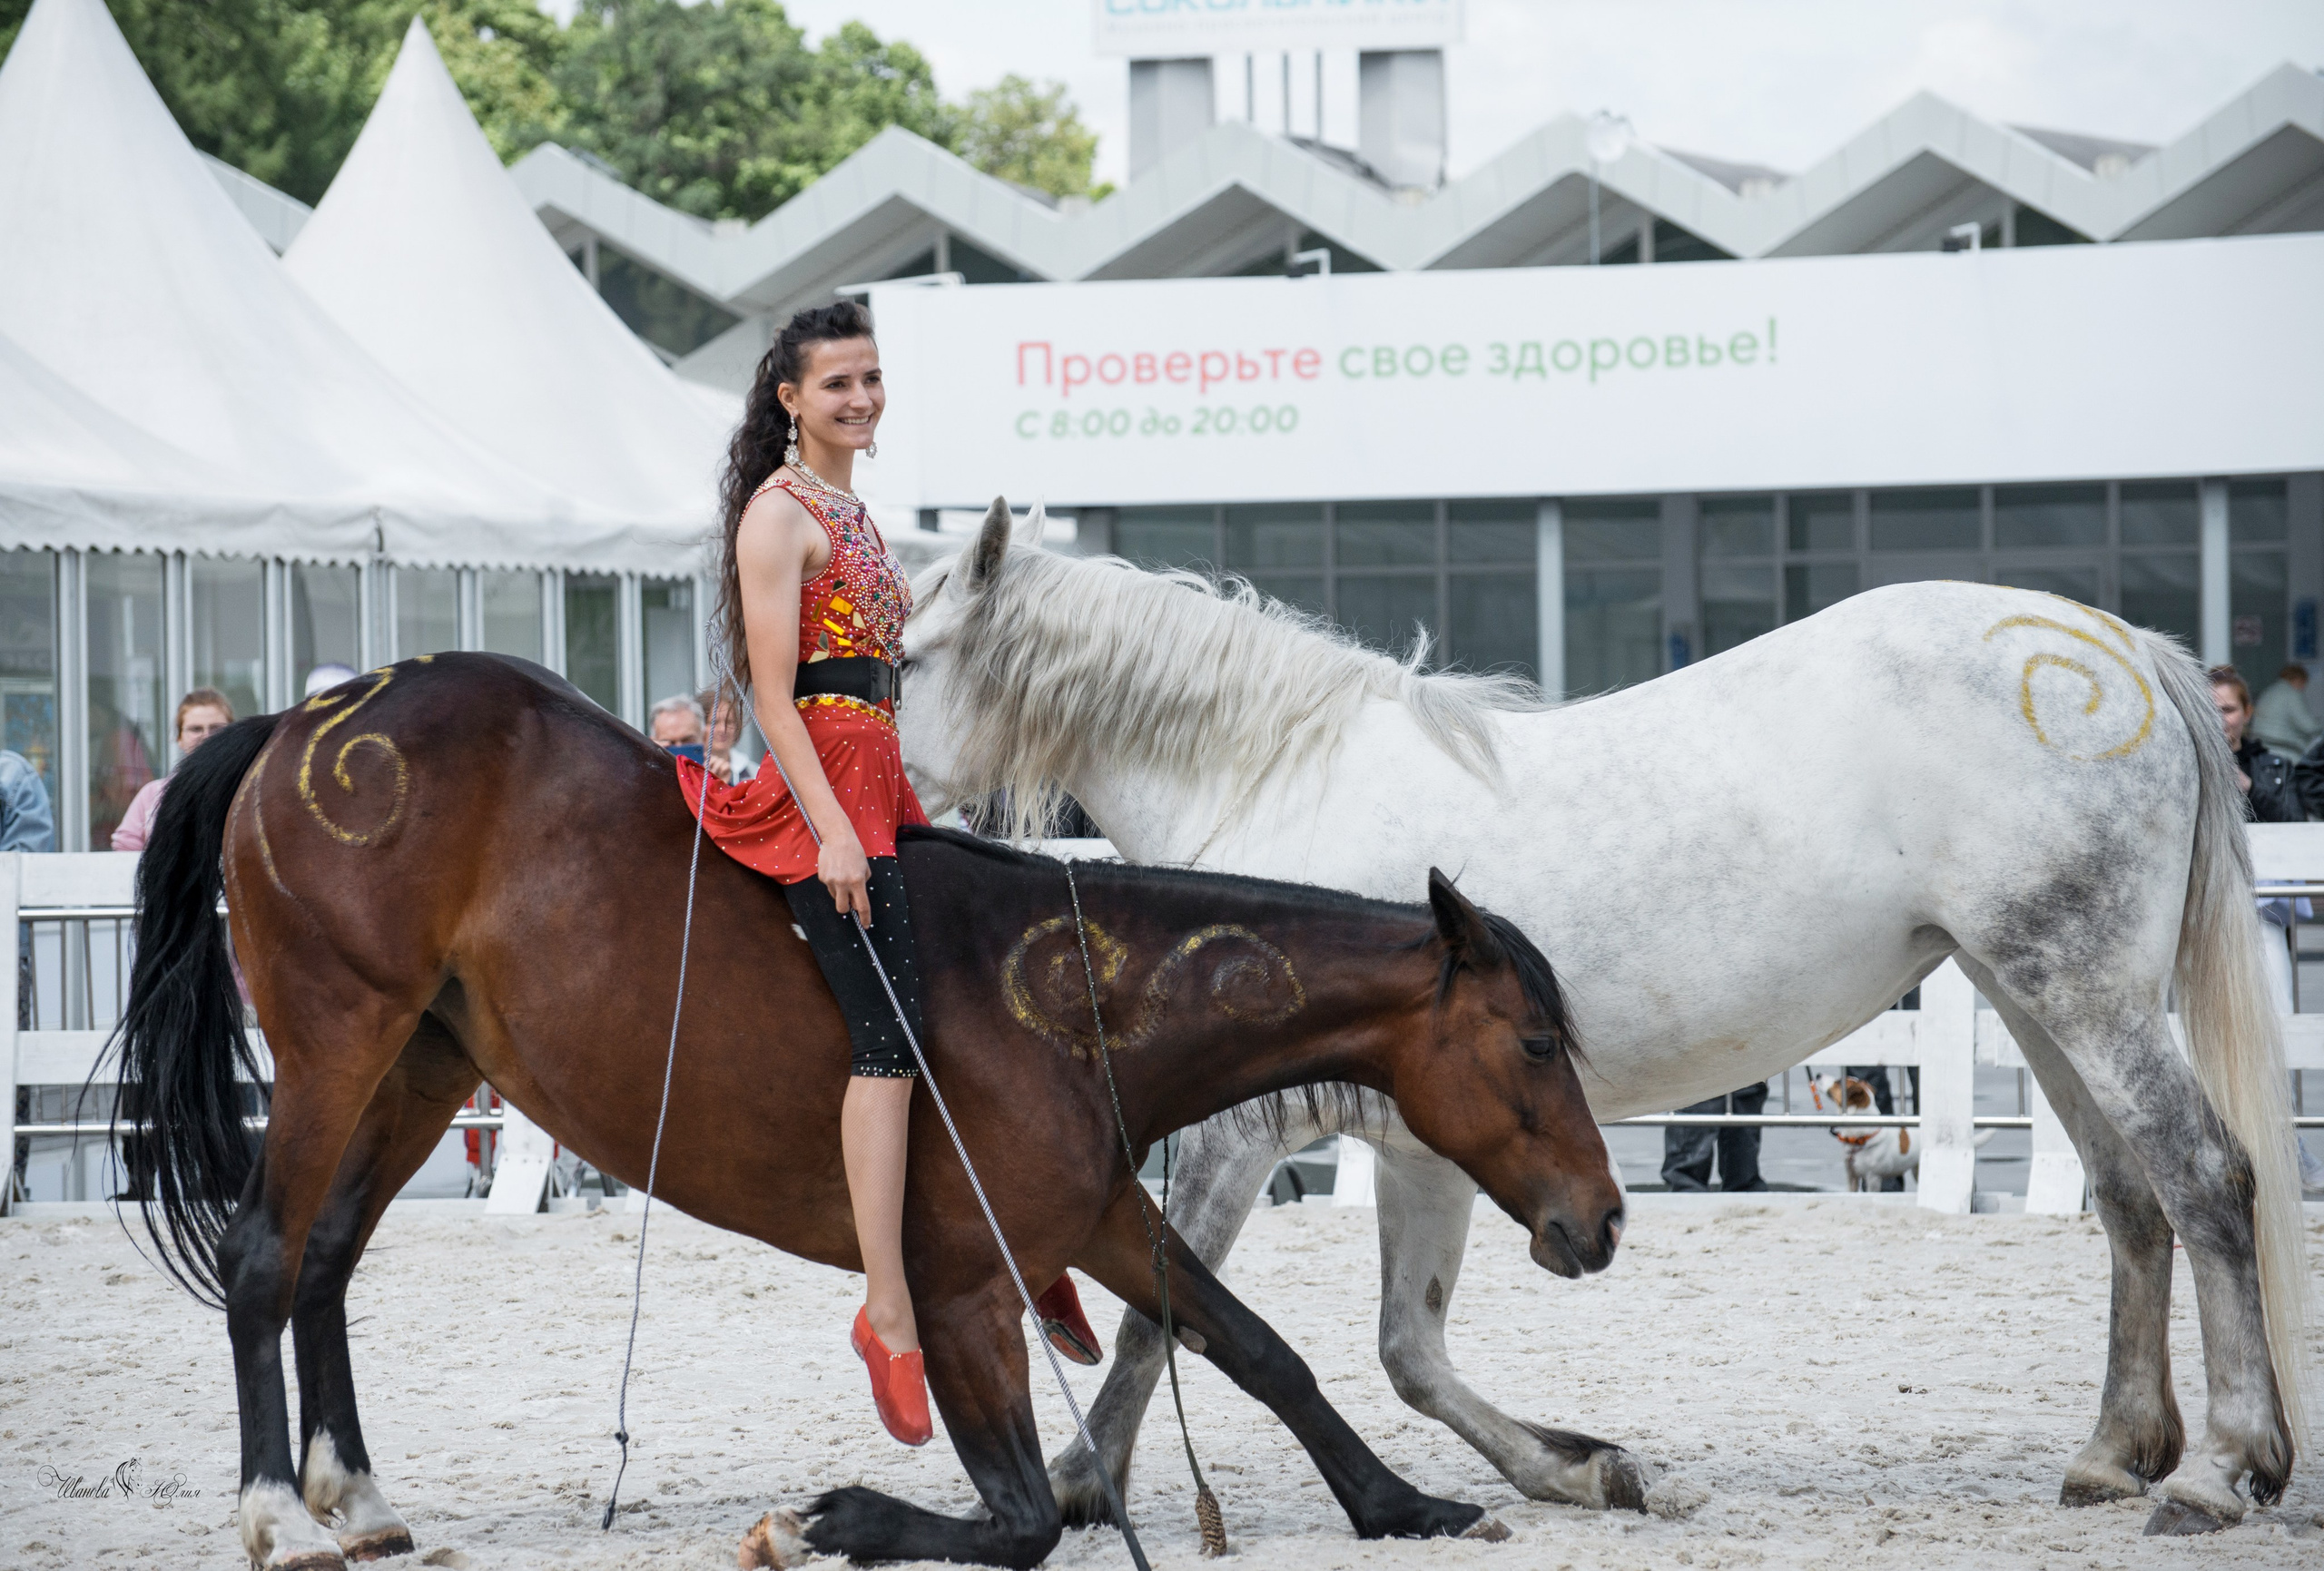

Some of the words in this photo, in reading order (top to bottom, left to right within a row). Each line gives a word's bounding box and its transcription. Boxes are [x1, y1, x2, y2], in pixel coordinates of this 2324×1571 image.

[1014, 339, 1324, 398] Проверьте
[1337, 344, 1472, 379] свое
[1487, 316, 1778, 384] здоровье!
[1049, 408, 1132, 438] 8:00
[1138, 407, 1183, 437] до
[1189, 405, 1300, 436] 20:00
